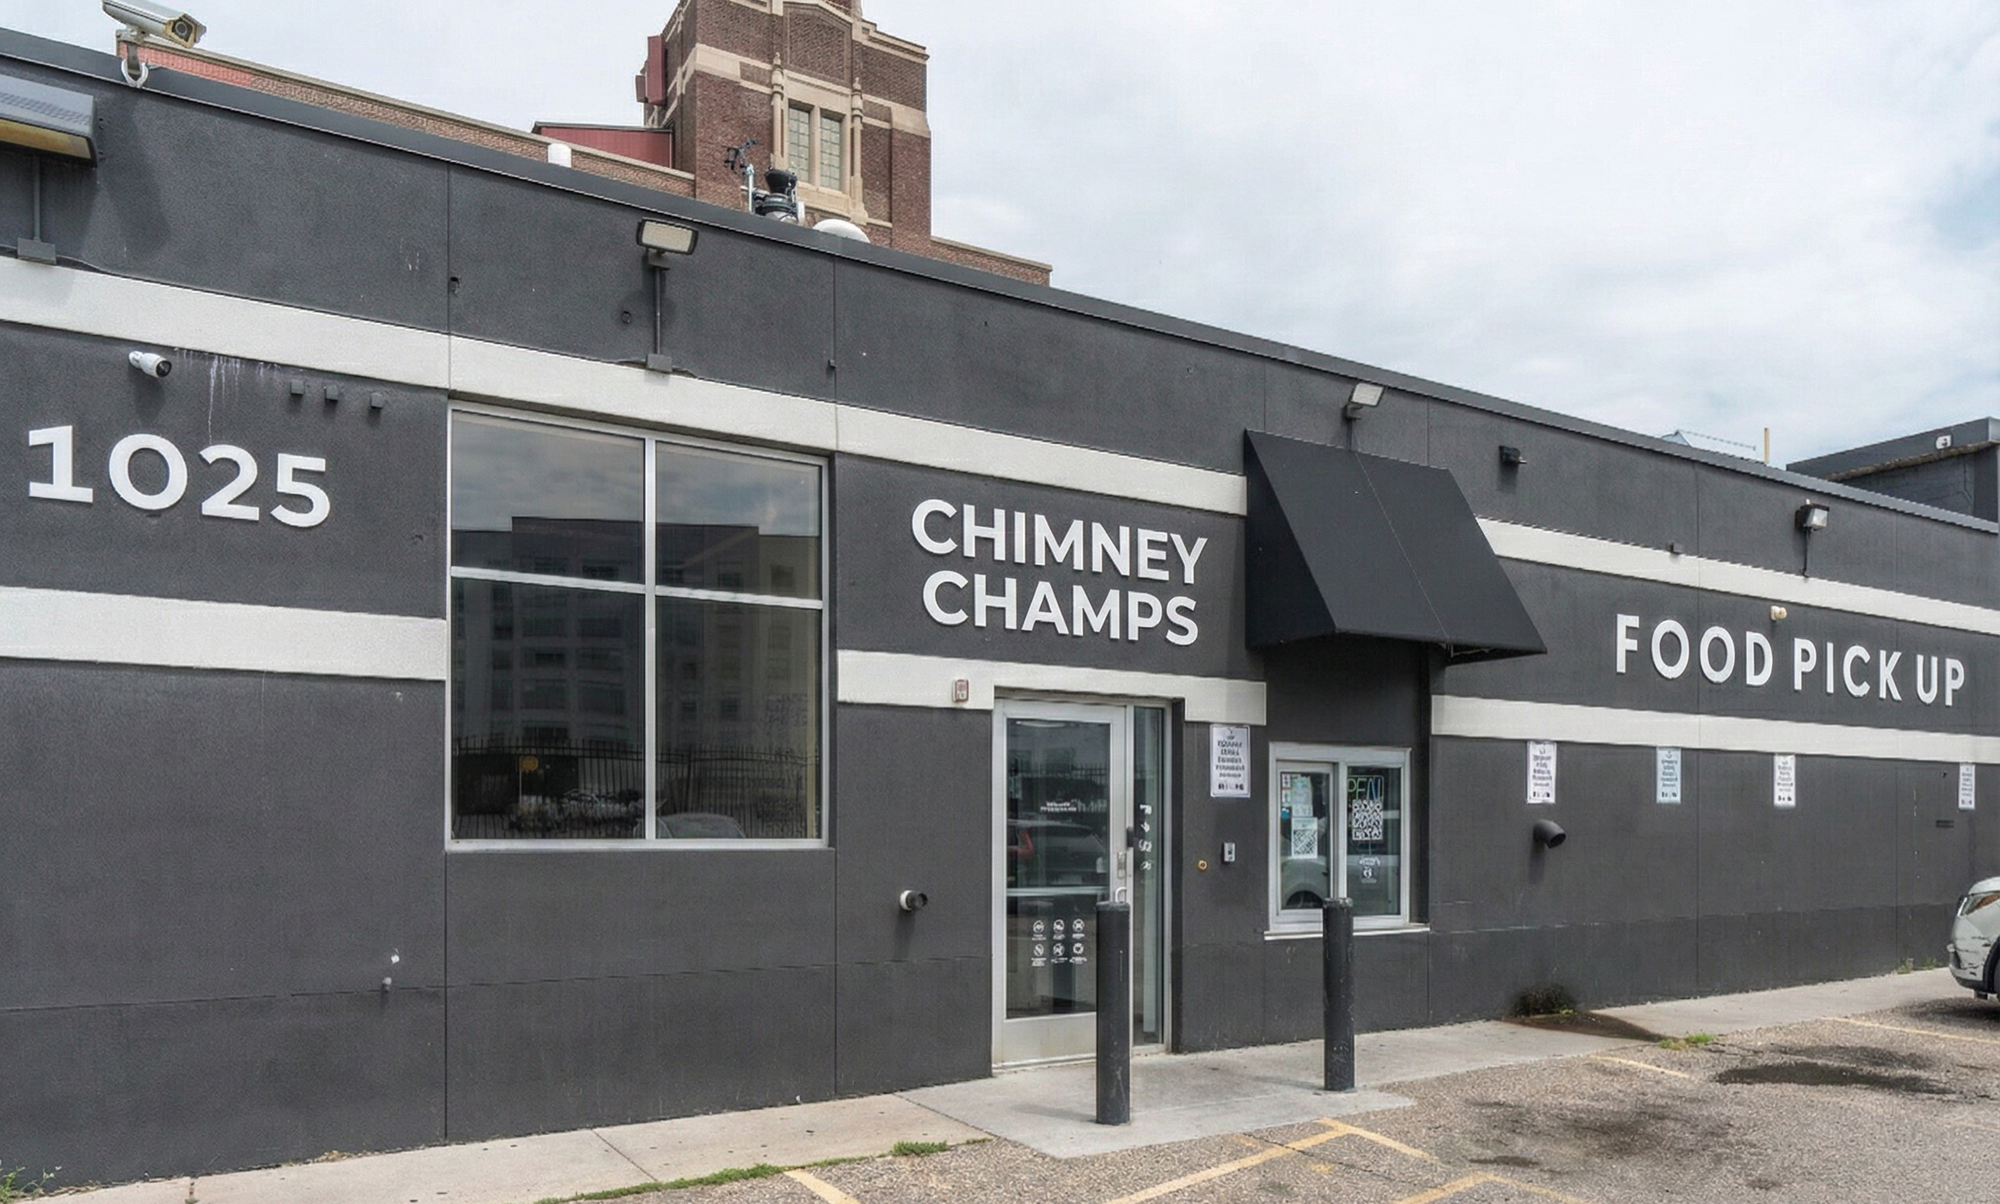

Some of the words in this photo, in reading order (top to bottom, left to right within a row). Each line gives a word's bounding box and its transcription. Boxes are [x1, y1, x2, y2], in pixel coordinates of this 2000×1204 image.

[28, 424, 332, 528] 1025
[911, 499, 1208, 584] CHIMNEY
[922, 571, 1199, 645] CHAMPS
[1616, 614, 1774, 684] FOOD
[1793, 638, 1903, 701] PICK
[1917, 655, 1965, 707] UP
